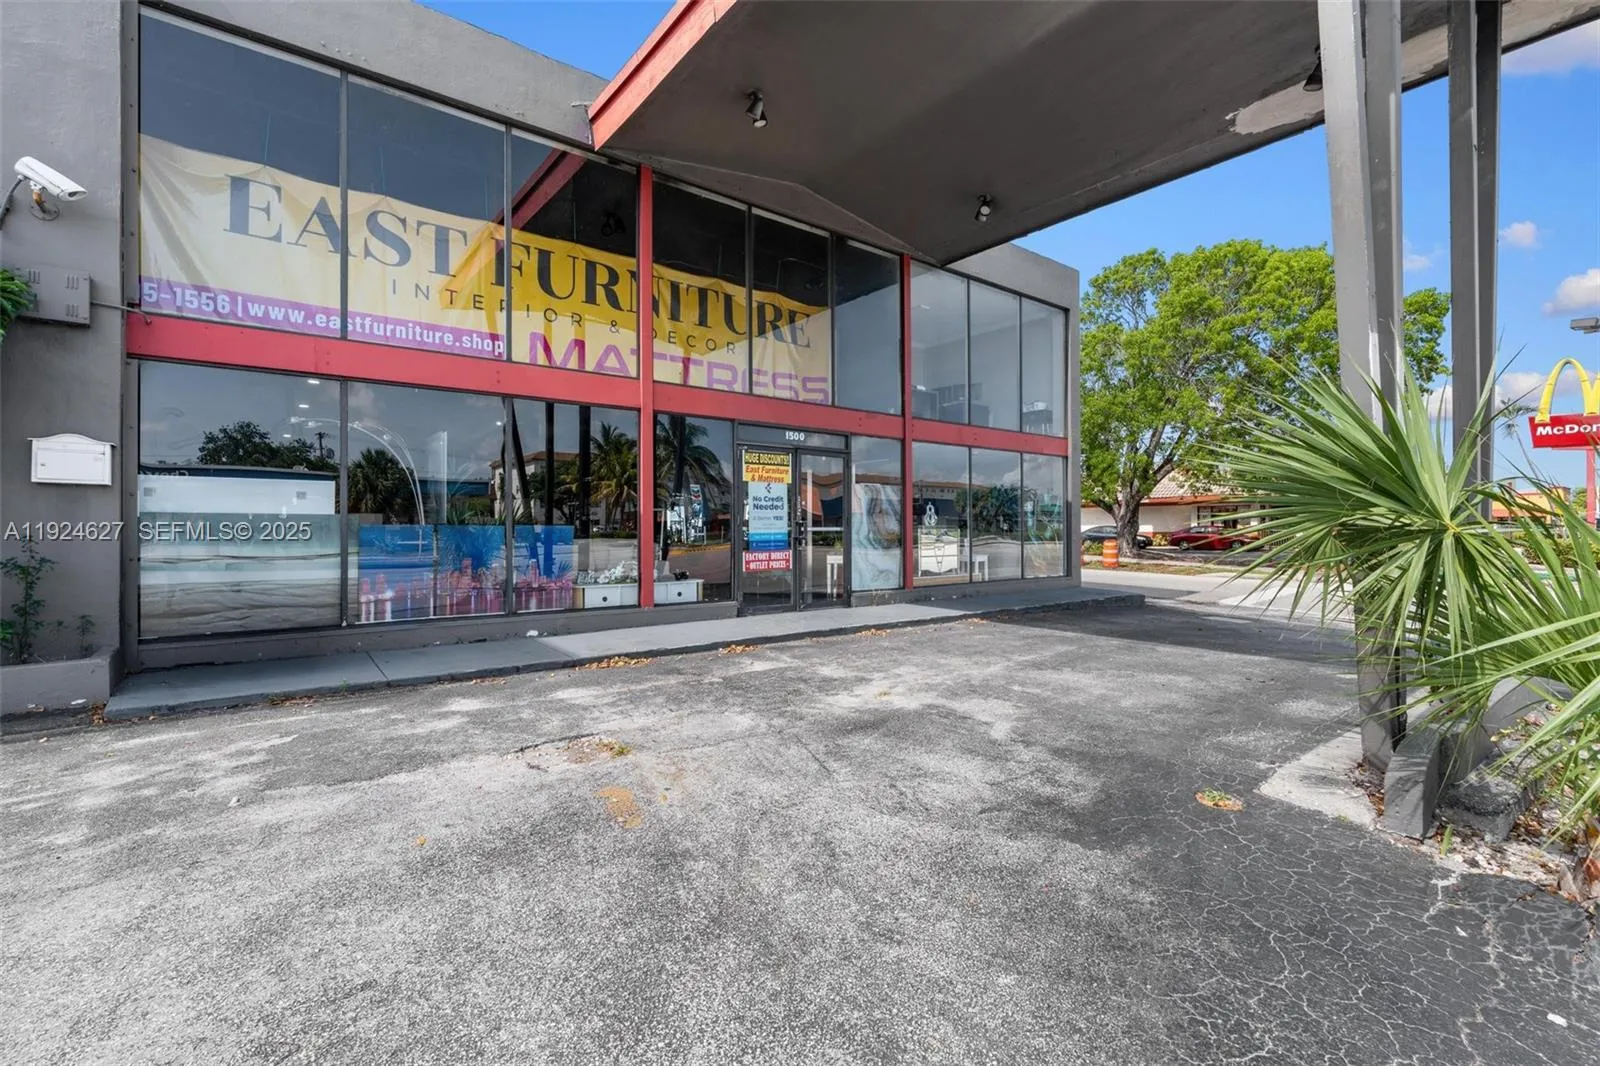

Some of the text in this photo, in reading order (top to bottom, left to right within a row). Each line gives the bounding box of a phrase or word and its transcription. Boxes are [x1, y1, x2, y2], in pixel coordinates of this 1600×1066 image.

[224, 174, 811, 349] EAST FURNITURE
[248, 301, 504, 356] www.eastfurniture.shop
[609, 319, 621, 335] &
[785, 431, 805, 441] 1500
[762, 466, 789, 475] Furniture
